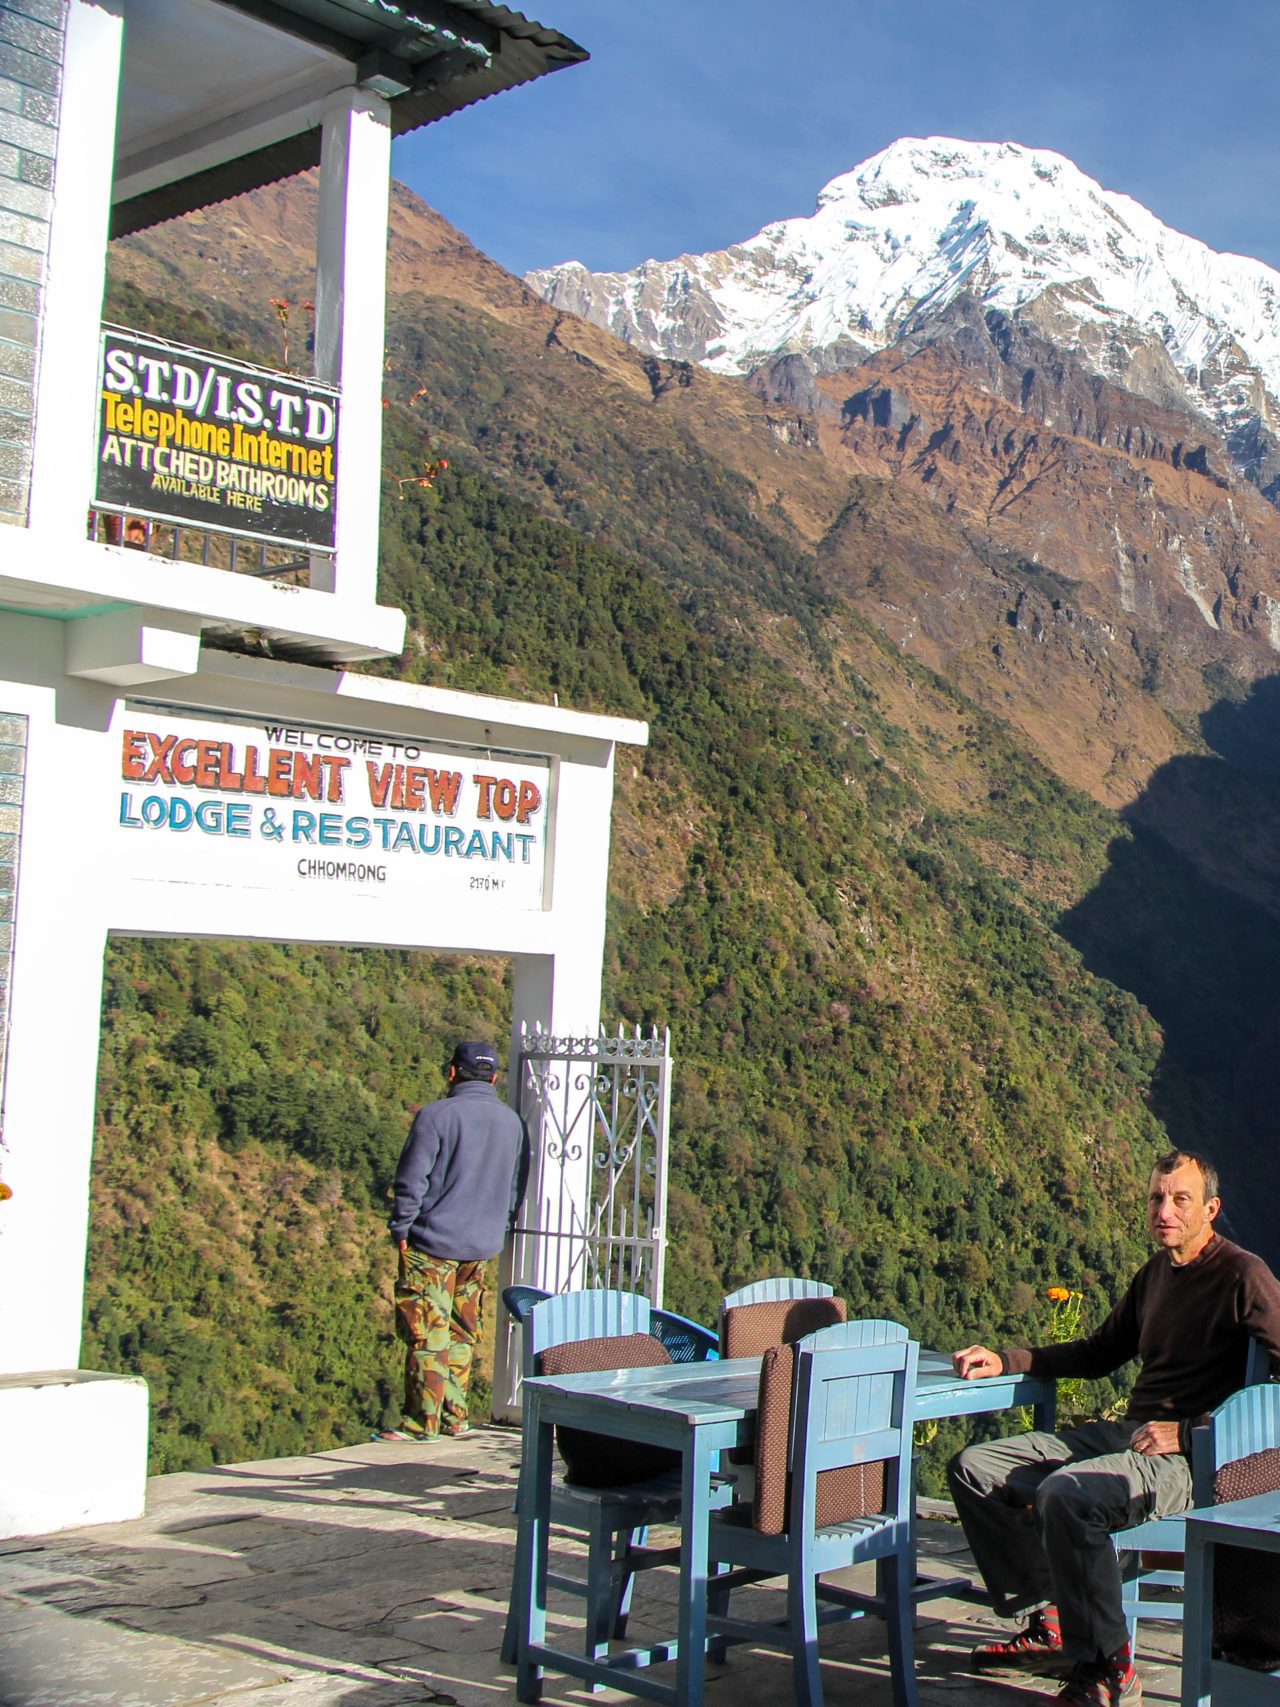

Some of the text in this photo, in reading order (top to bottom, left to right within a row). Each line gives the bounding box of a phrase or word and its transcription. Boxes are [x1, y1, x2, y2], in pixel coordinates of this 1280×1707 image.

[102, 391, 335, 482] Telephone Internet
[102, 435, 329, 511] ATTCHED BATHROOMS
[152, 475, 262, 512] AVAILABLE HERE
[121, 730, 542, 824] EXCELLENT VIEW TOP
[265, 726, 420, 760] WELCOME TO
[120, 793, 537, 863] LODGE & RESTAURANT
[297, 858, 387, 883] CHHOMRONG
